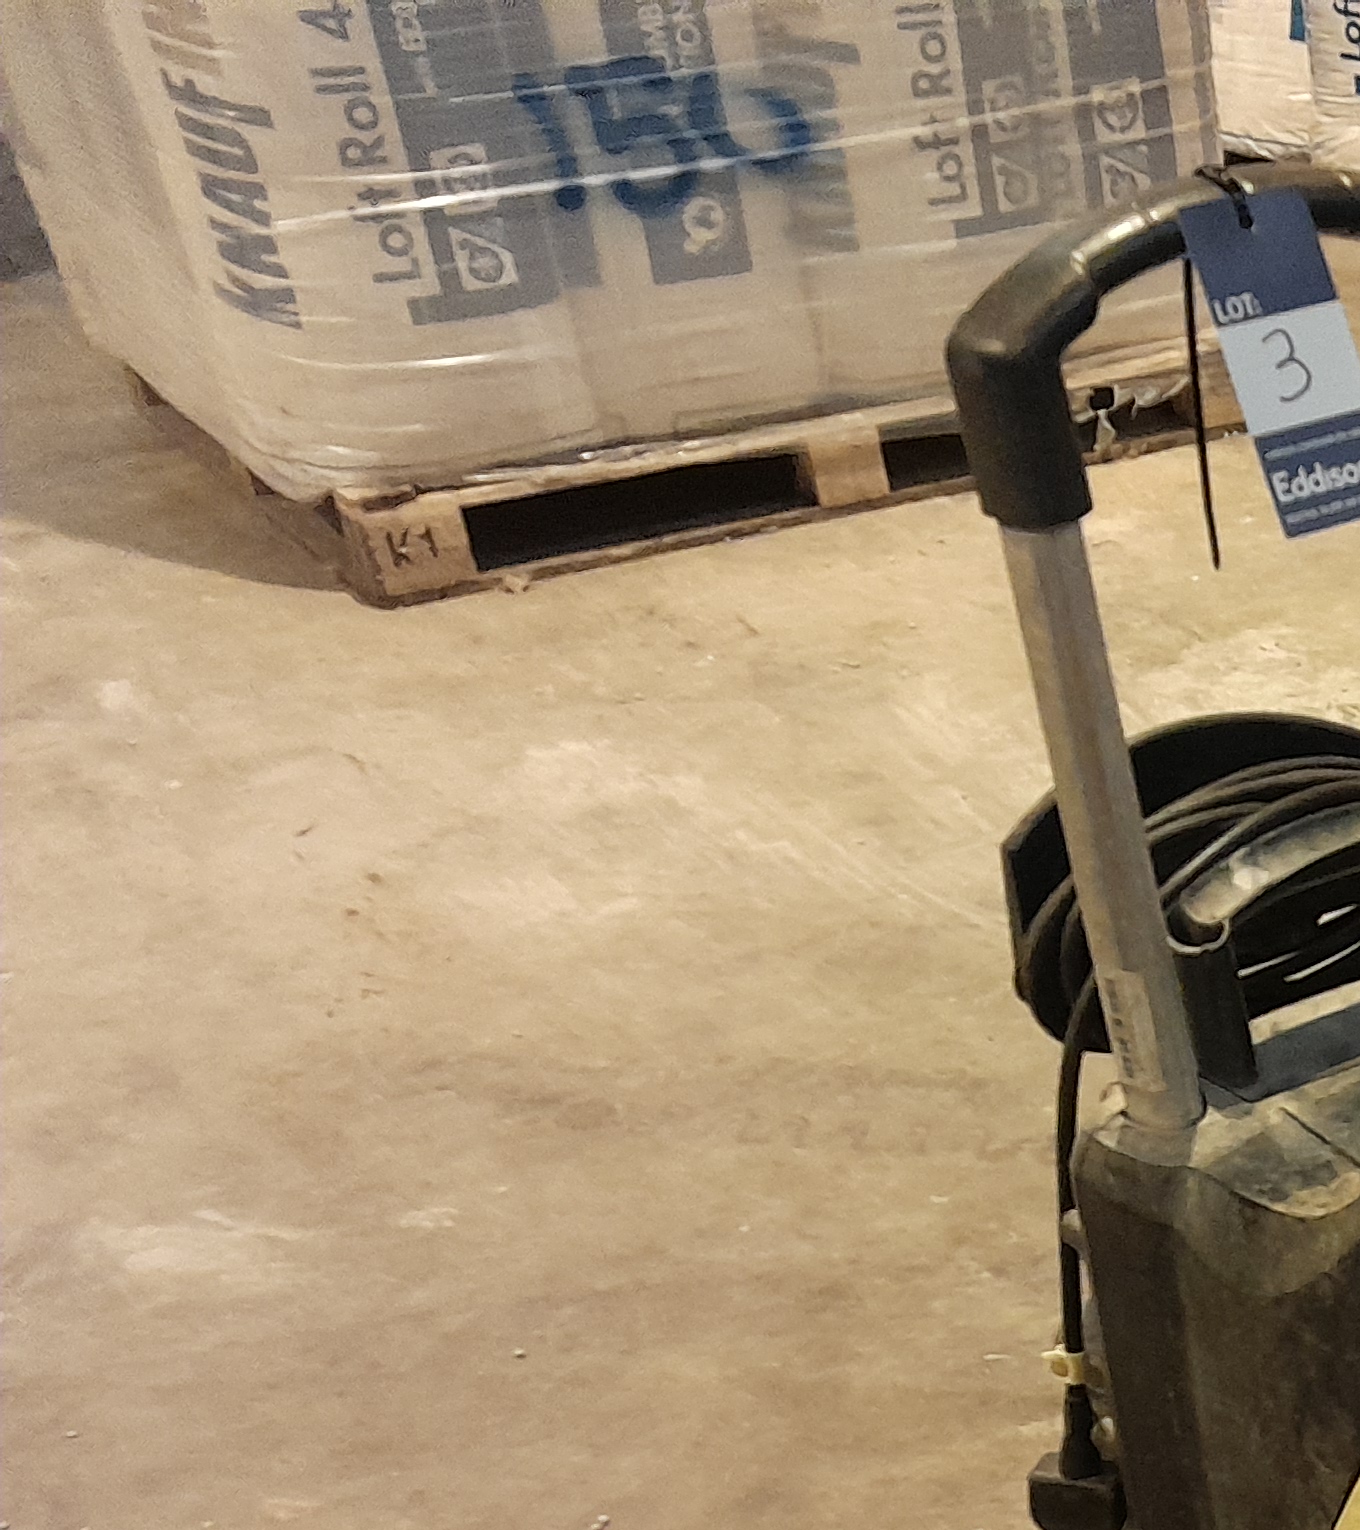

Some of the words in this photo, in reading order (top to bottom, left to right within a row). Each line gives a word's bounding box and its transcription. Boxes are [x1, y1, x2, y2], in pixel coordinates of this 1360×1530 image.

[308, 65, 388, 167] Roll
[160, 67, 302, 329] KNAUF
[1262, 328, 1313, 403] 3
